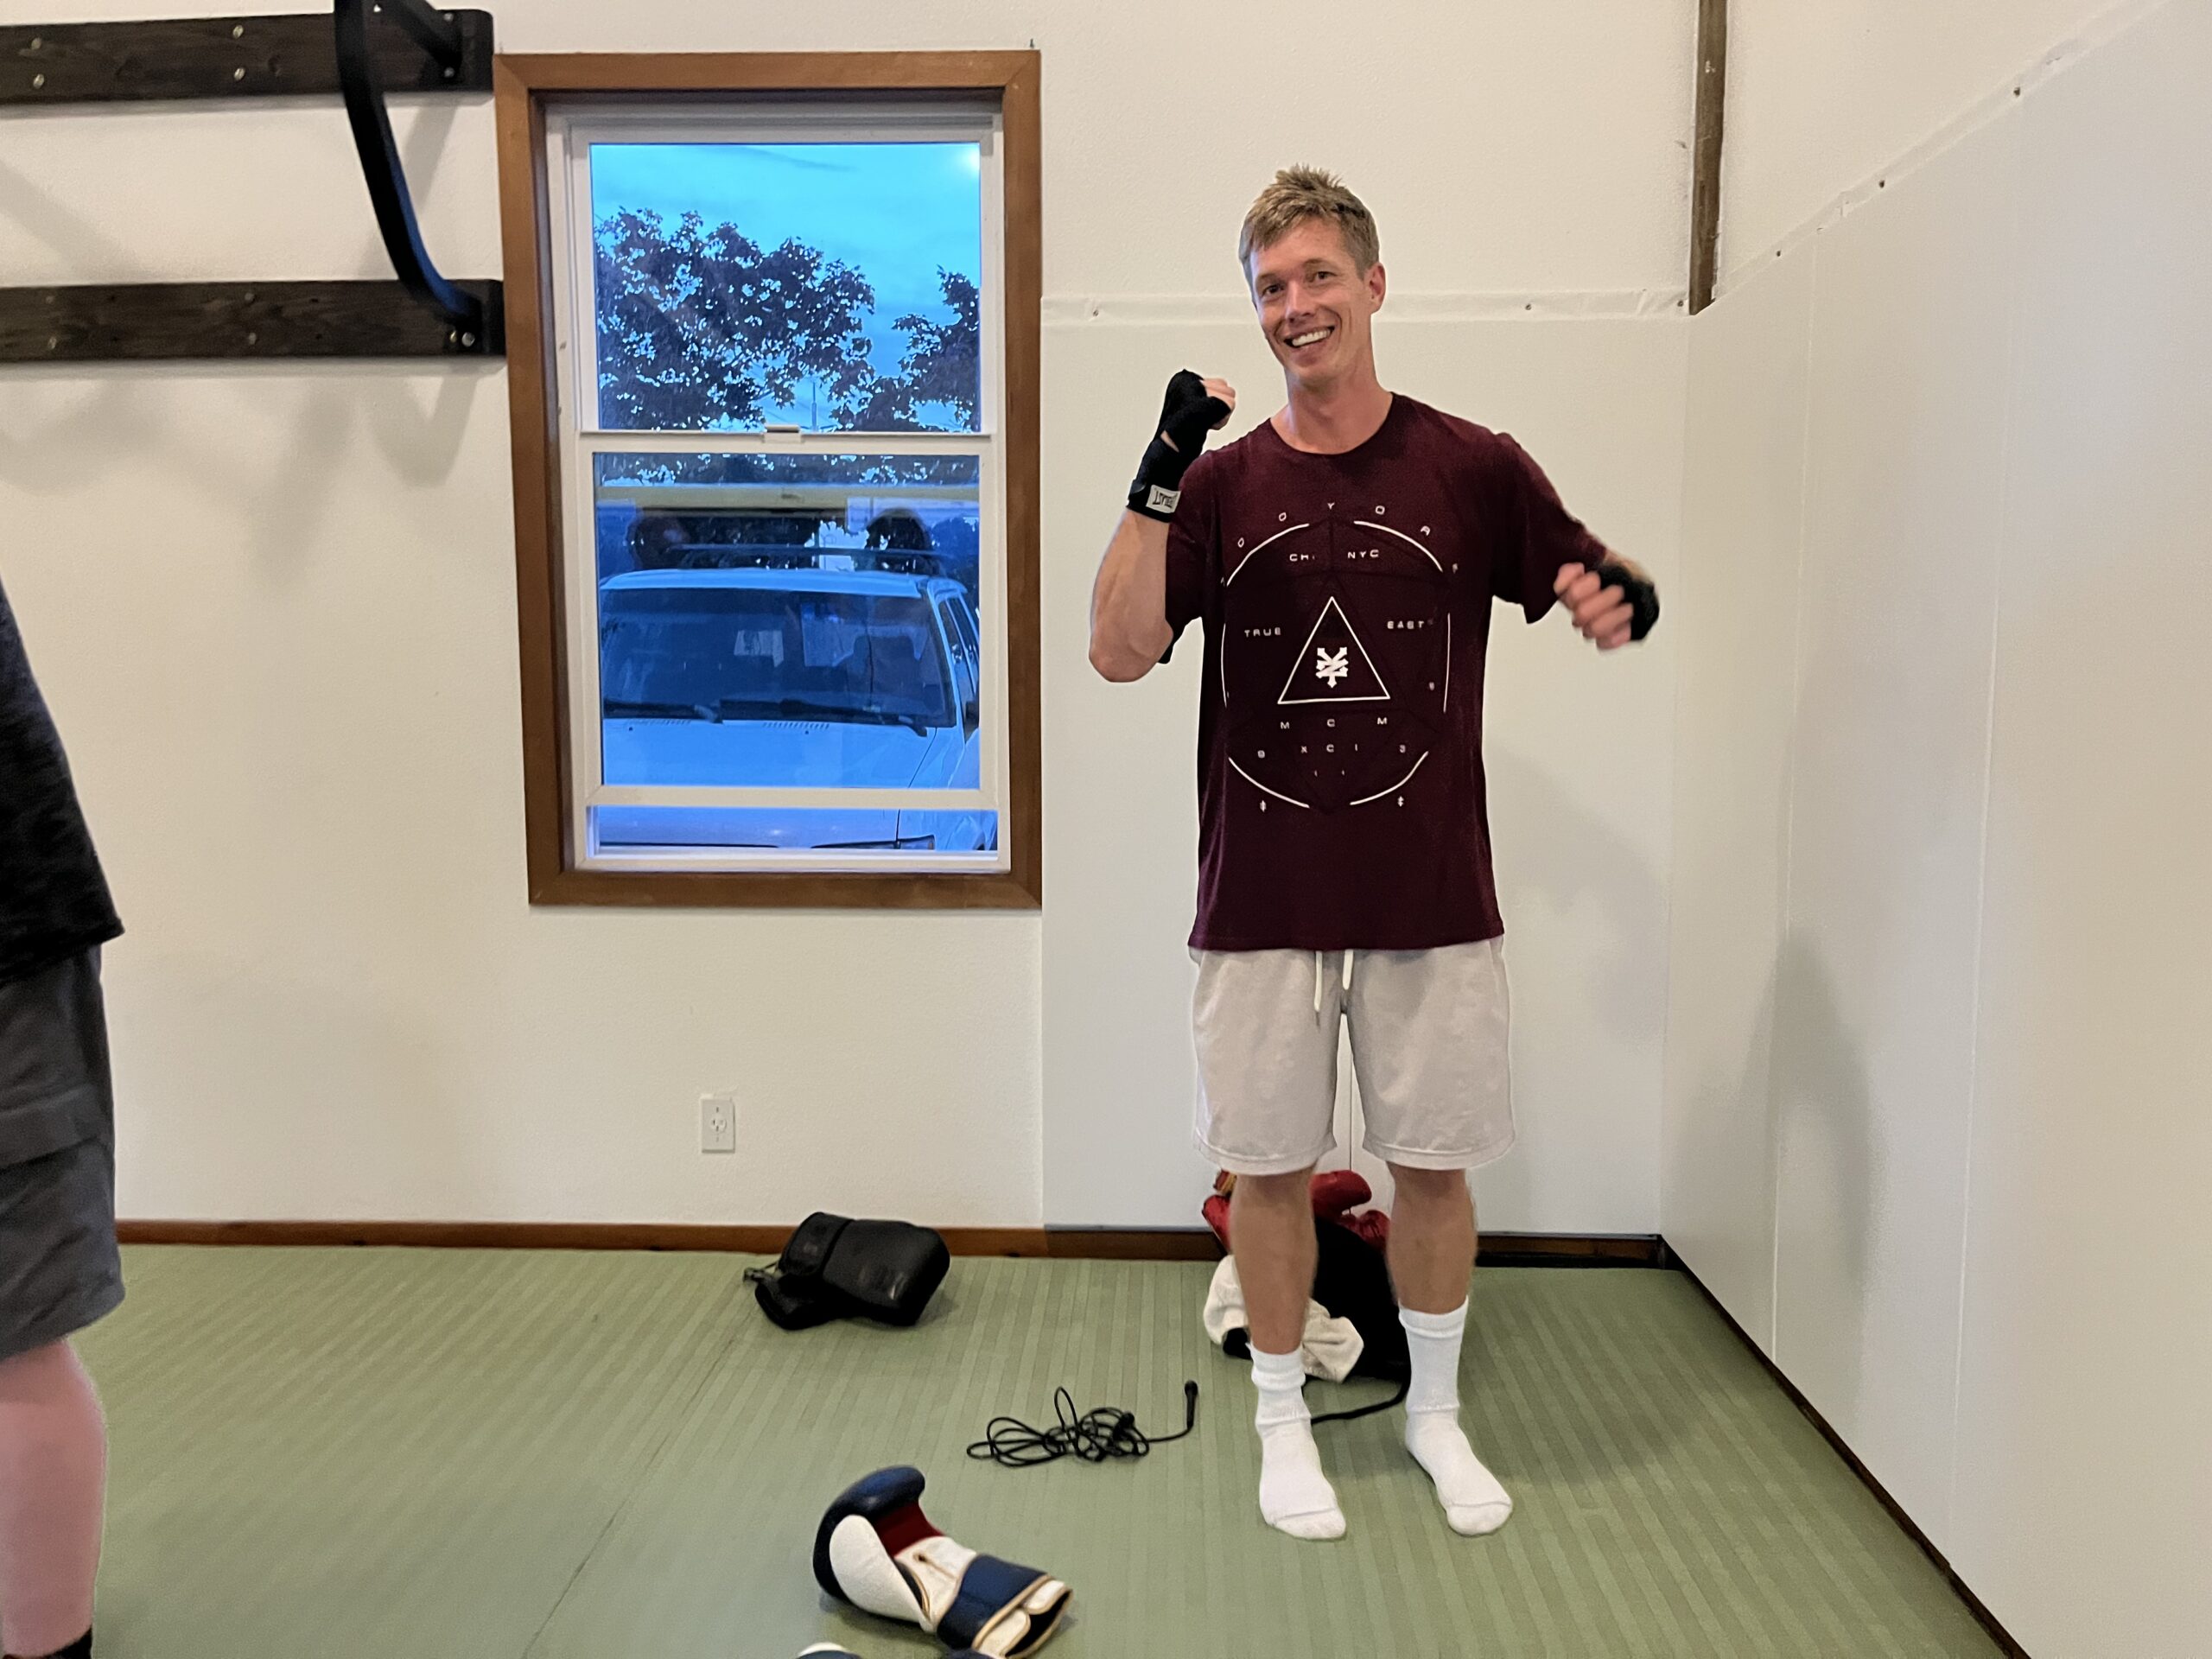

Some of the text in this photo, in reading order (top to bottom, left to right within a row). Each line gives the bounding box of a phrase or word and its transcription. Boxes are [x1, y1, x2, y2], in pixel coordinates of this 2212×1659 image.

[1347, 550, 1379, 559] NYC
[1244, 620, 1425, 638] TRUE EAST
